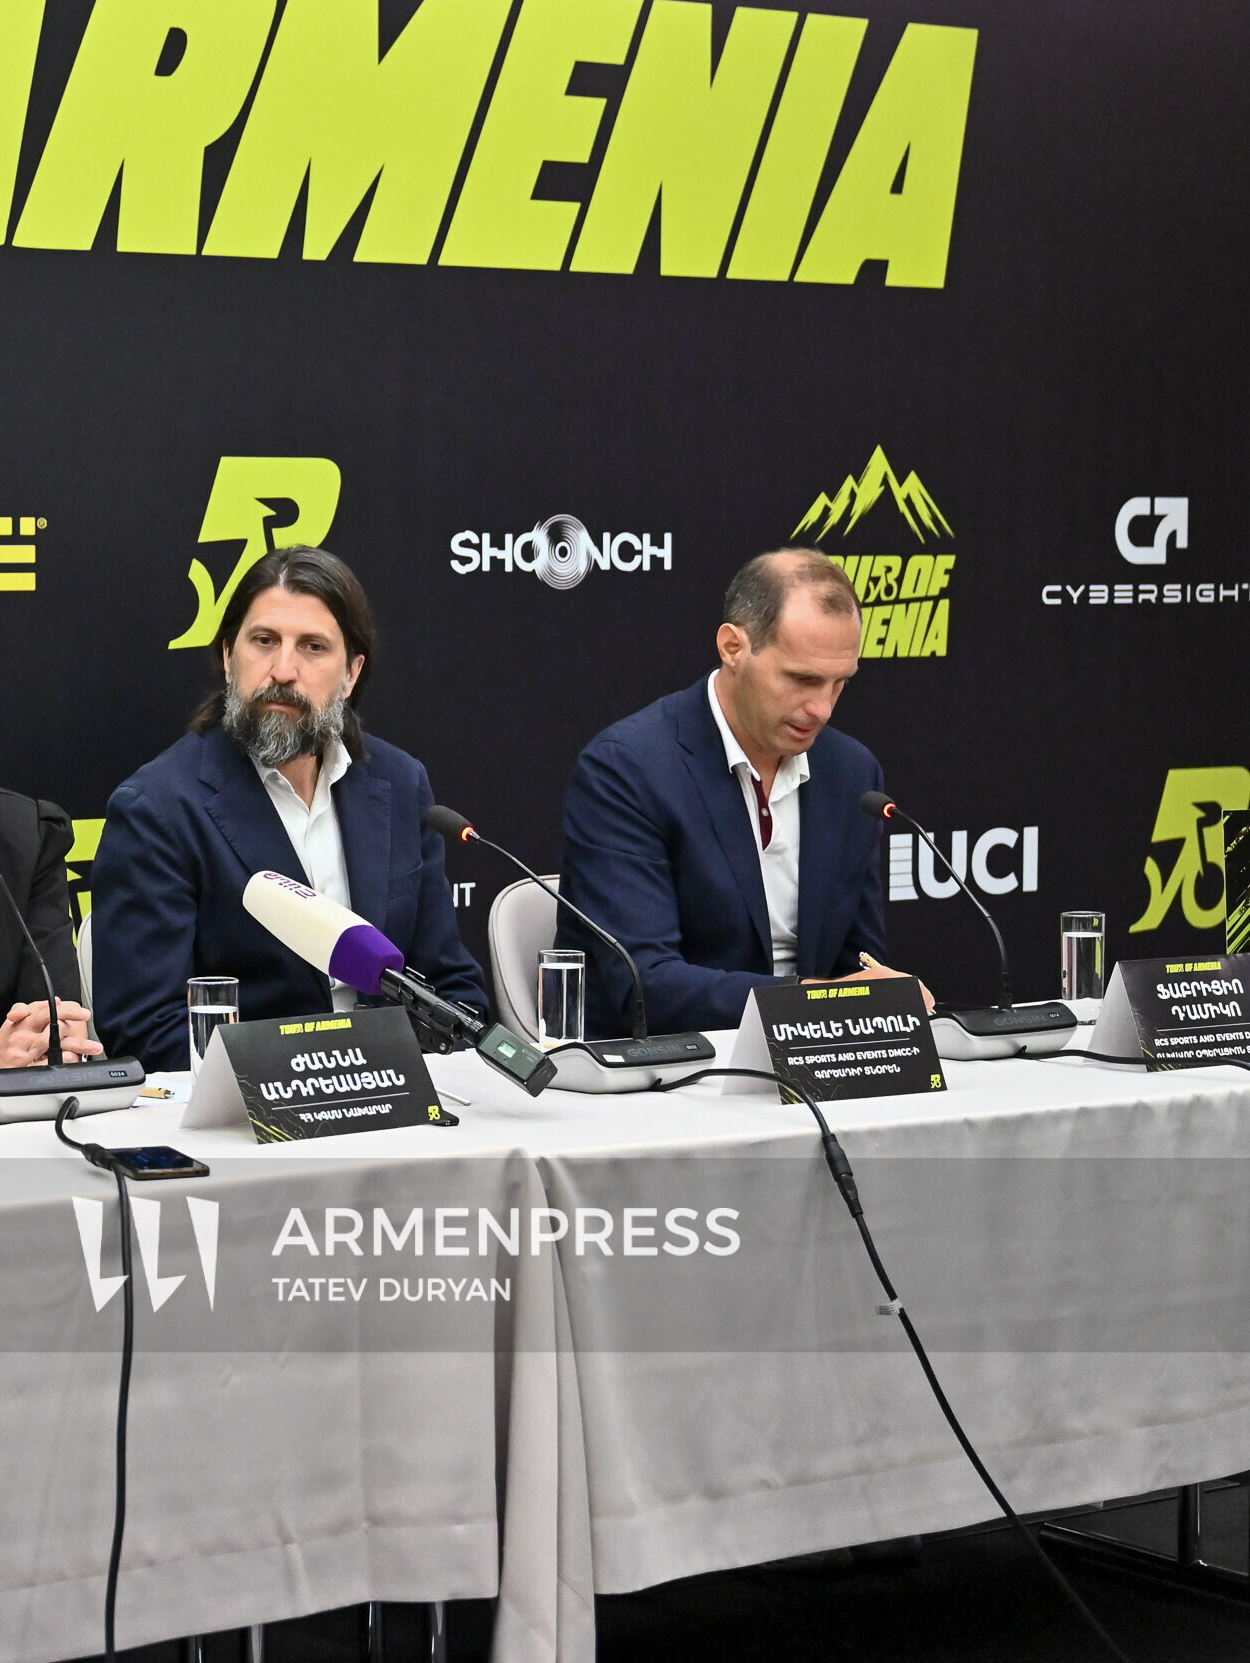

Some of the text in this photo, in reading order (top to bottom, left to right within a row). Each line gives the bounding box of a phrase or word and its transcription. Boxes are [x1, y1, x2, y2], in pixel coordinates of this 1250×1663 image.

[898, 554, 956, 600] OF
[918, 826, 1039, 899] UCI
[1156, 978, 1244, 1000] ՖԱԲՐԻՑԻՈ
[772, 1014, 921, 1042] ՄԻԿԵԼԵ ՆԱՊՈԼԻ
[1154, 1037, 1169, 1047] RCS
[1170, 1035, 1198, 1046] SPORTS
[1199, 1034, 1215, 1043] AND
[1215, 1031, 1245, 1042] EVENTS
[290, 1047, 367, 1072] ԺԱՆՆԱ
[627, 1044, 679, 1057] GONSIN
[787, 1055, 805, 1066] RCS
[805, 1053, 837, 1065] SPORTS
[837, 1051, 856, 1062] AND
[856, 1049, 888, 1060] EVENTS
[260, 1068, 406, 1101] ԱՆԴՐԵԱՍՅԱՆ
